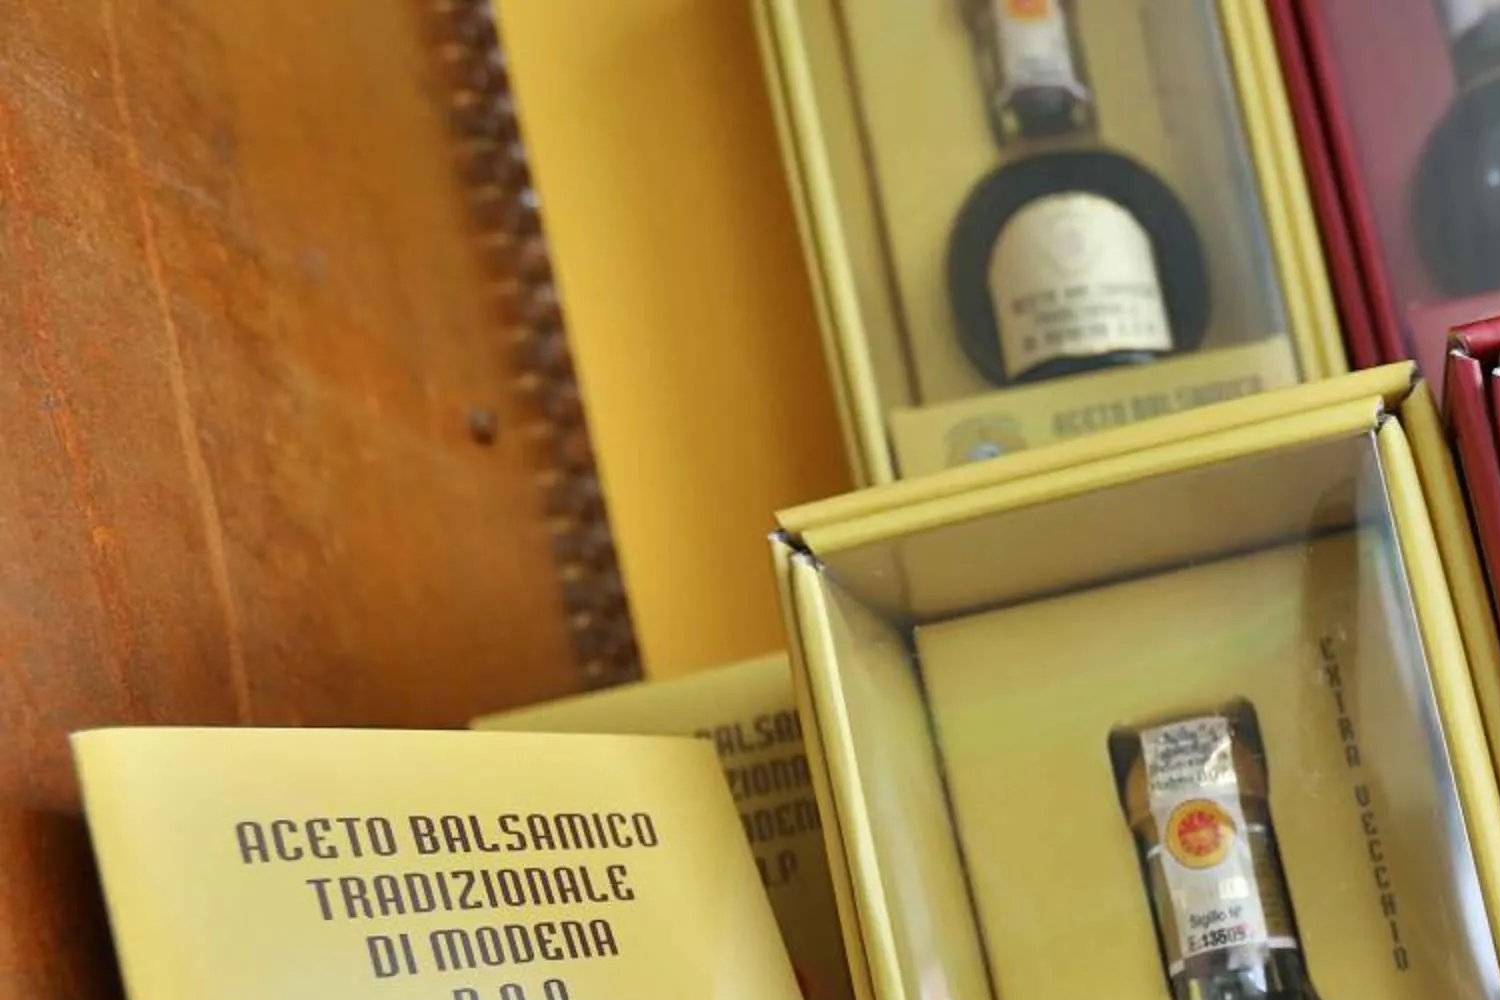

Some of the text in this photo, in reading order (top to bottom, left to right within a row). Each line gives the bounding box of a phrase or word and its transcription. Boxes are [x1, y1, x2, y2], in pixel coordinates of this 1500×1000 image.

[235, 812, 659, 864] ACETO BALSAMICO
[306, 864, 635, 921] TRADIZIONALE
[367, 919, 619, 979] DI MODENA
